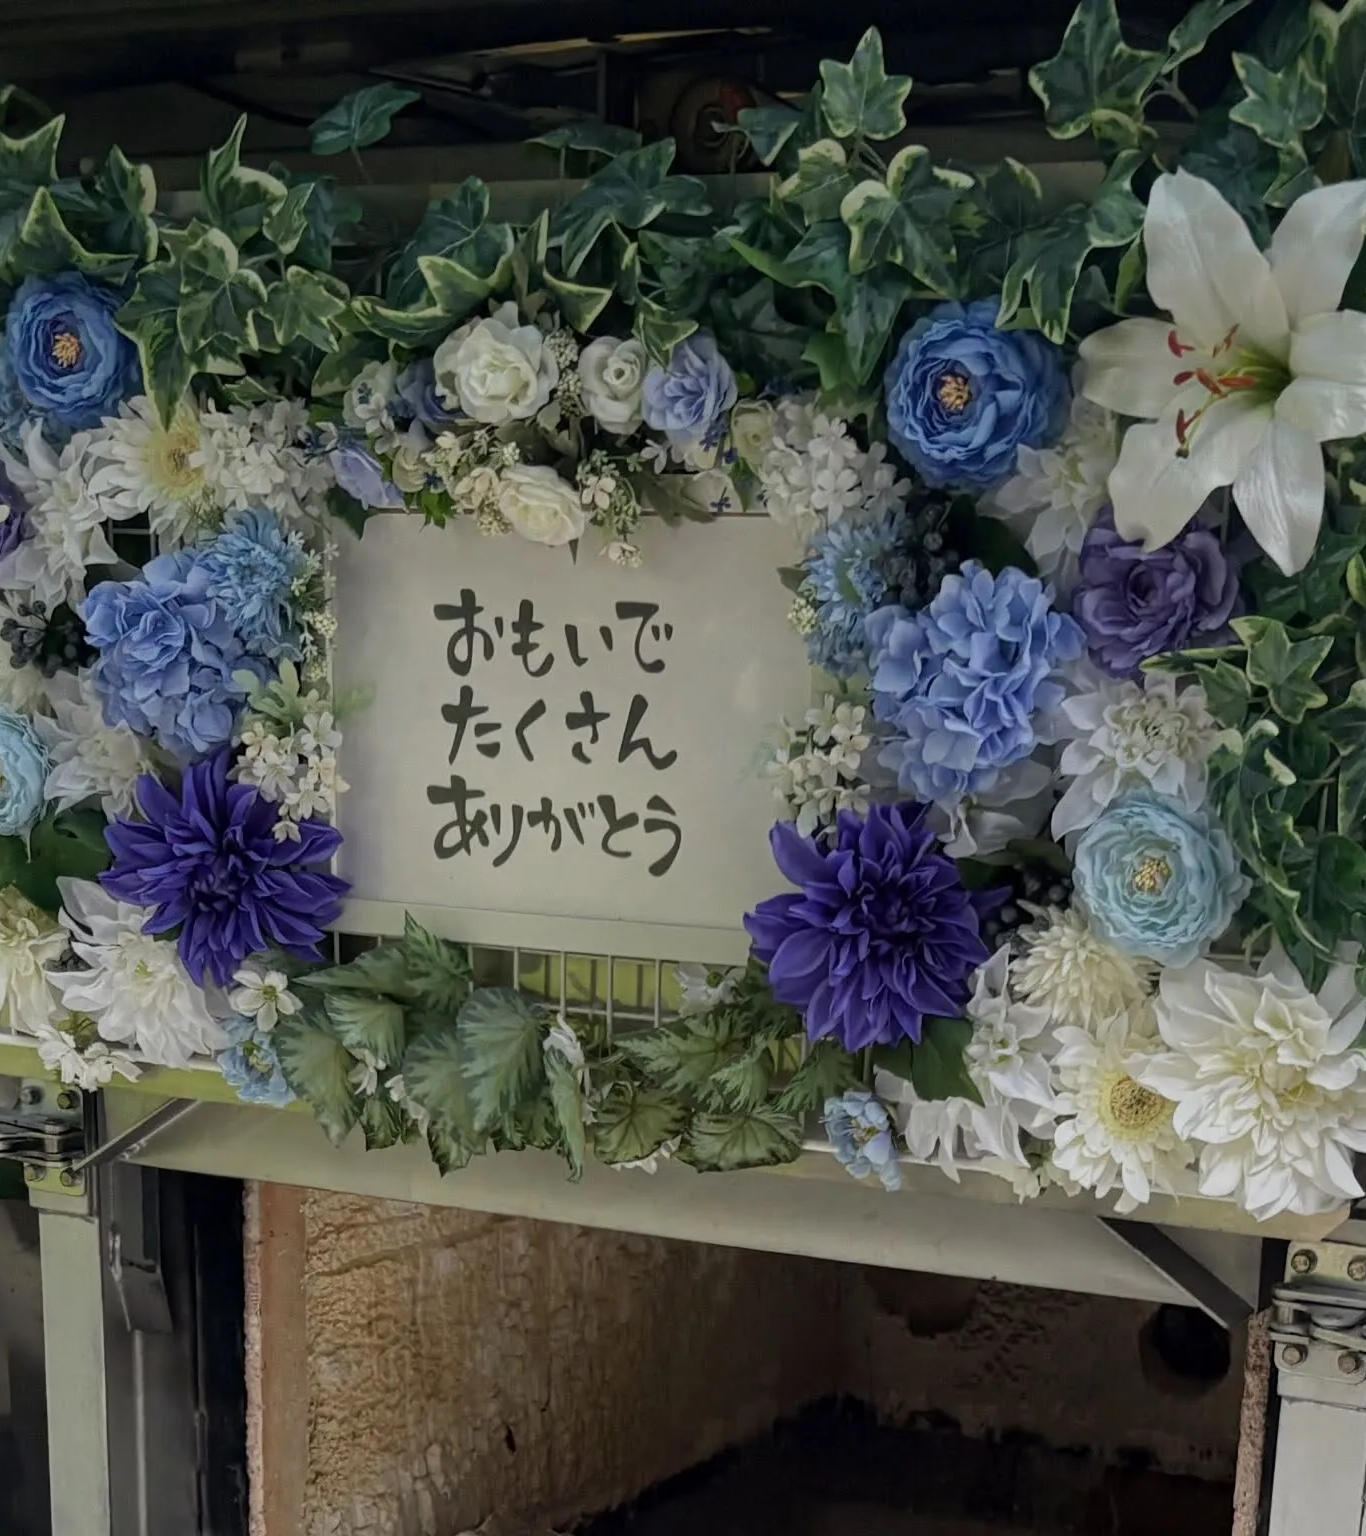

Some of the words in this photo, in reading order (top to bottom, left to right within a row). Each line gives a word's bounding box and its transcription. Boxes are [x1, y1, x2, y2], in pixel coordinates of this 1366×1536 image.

[433, 588, 674, 677] おもいで
[441, 685, 677, 770] たくさん
[427, 775, 682, 877] ありがとう
